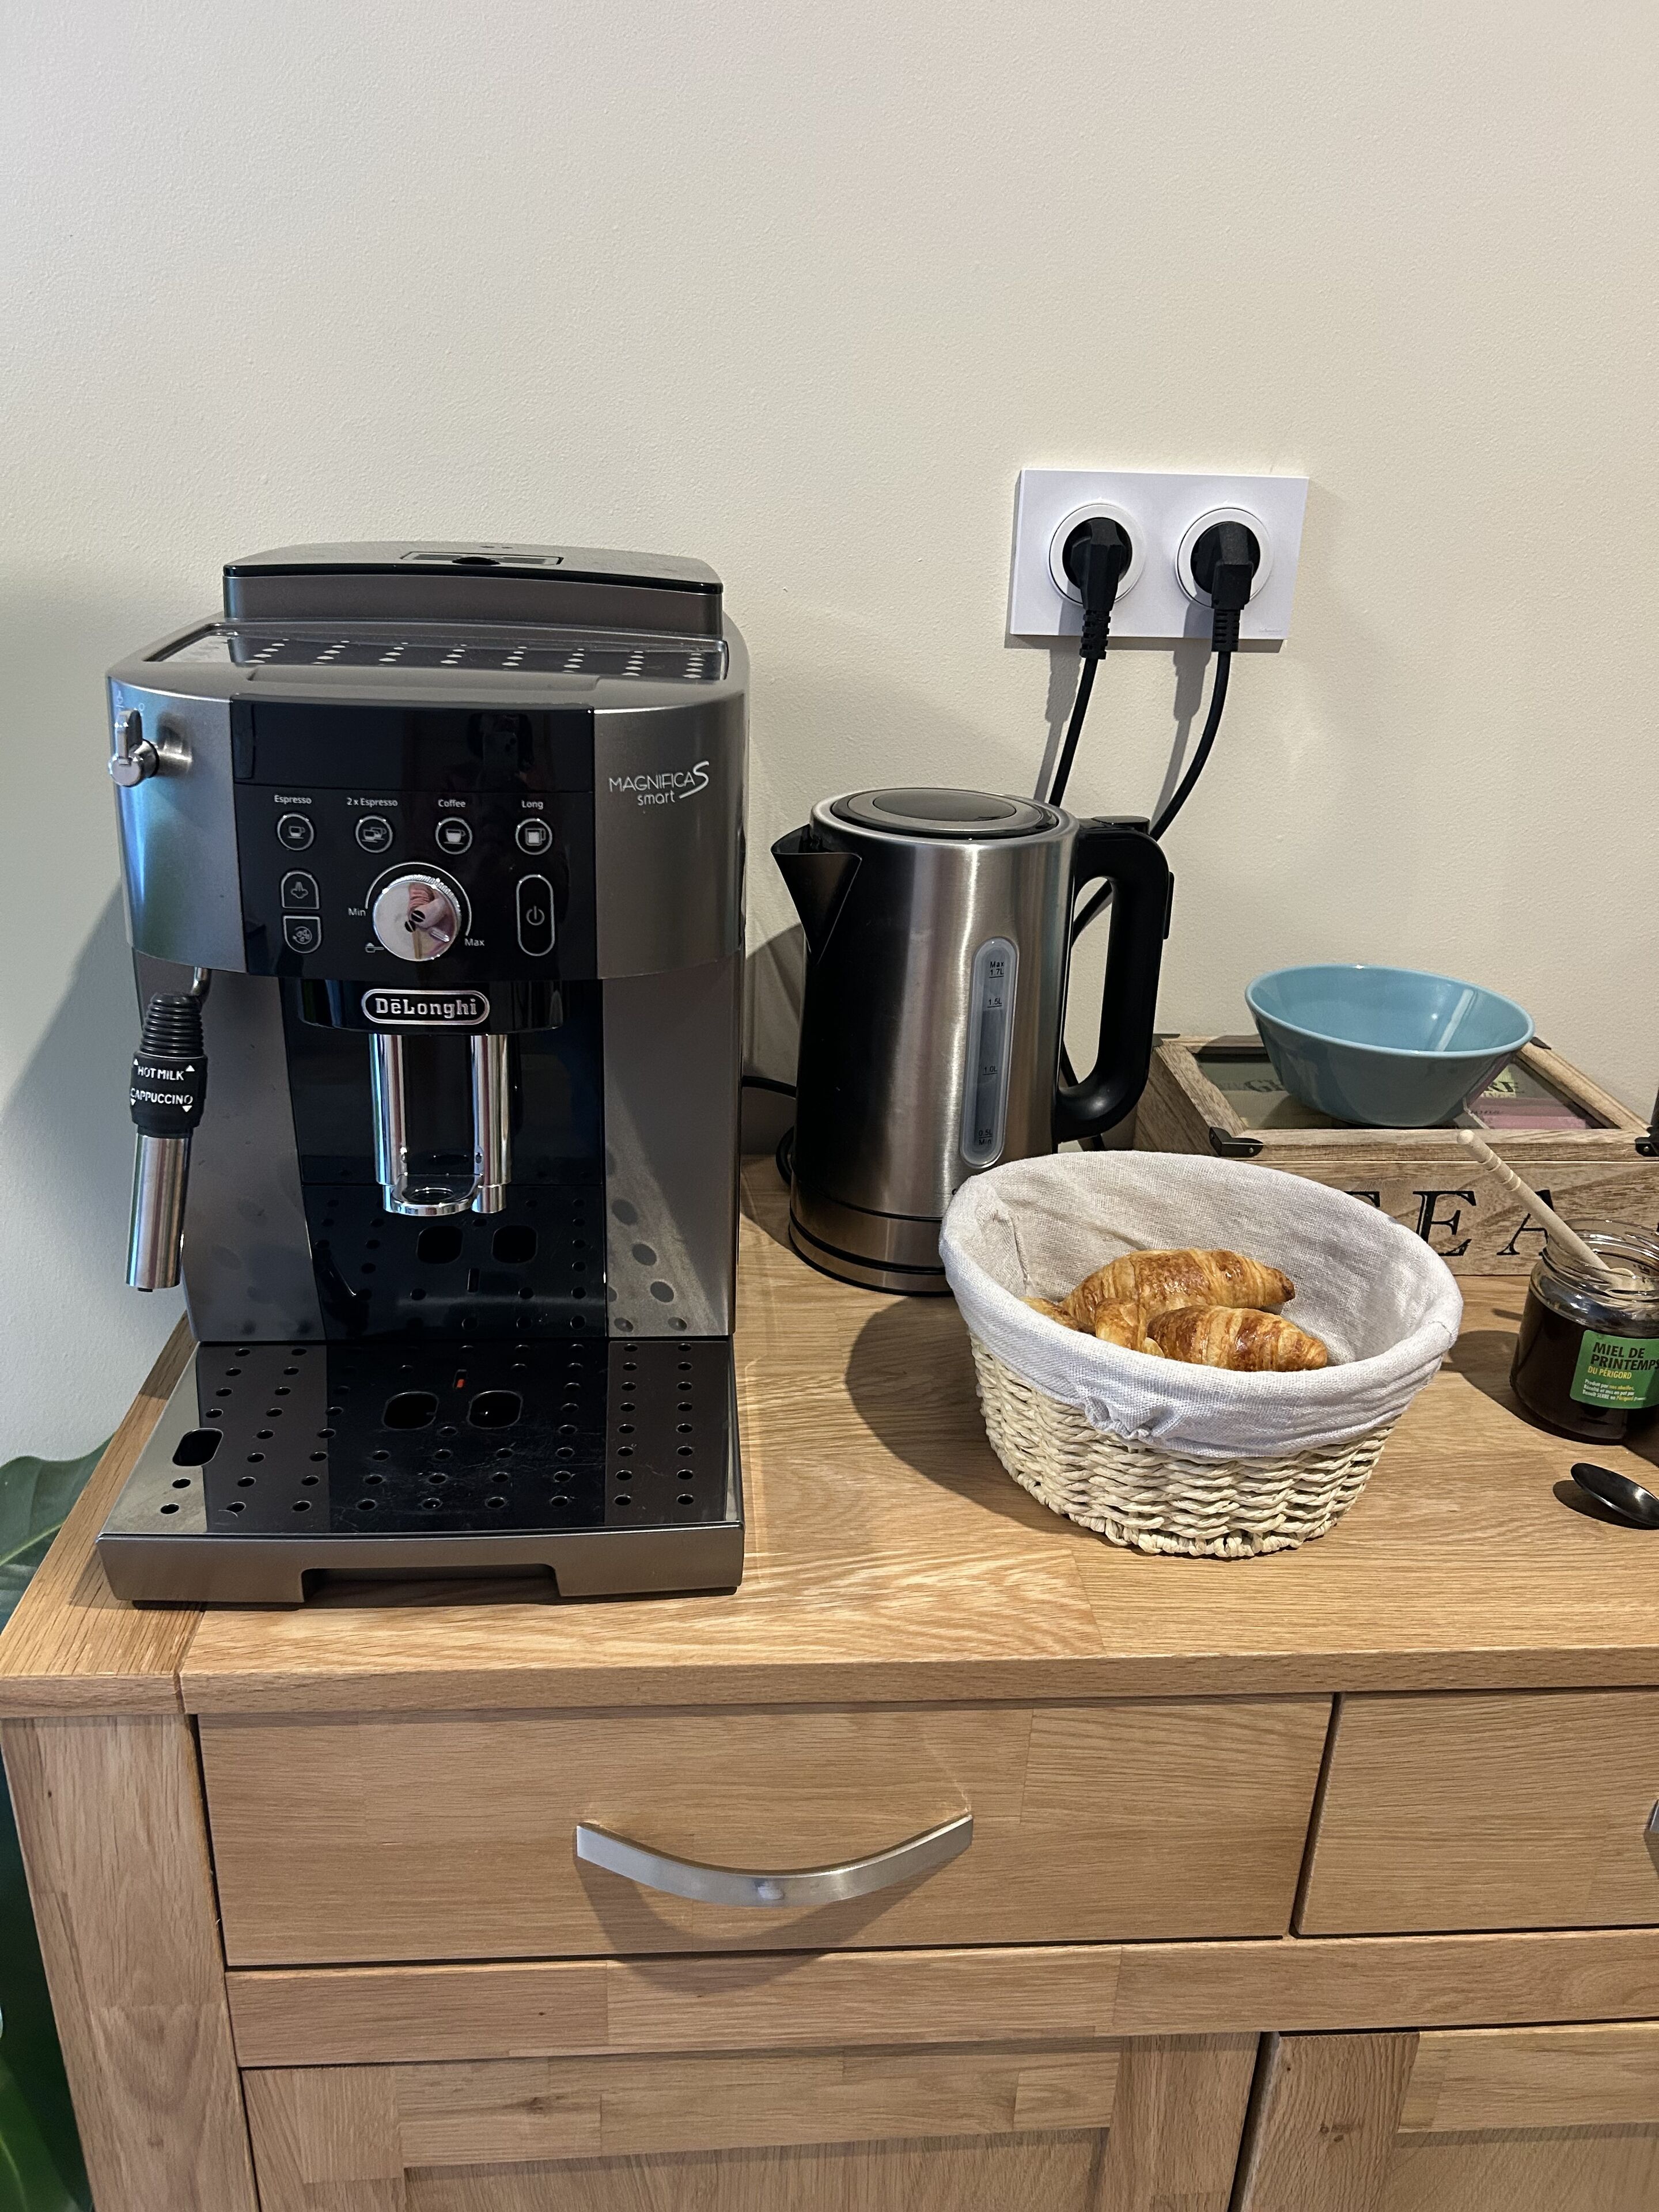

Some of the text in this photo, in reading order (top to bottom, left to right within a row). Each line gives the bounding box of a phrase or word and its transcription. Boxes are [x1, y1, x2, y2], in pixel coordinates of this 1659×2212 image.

[274, 795, 312, 805] Espresso
[347, 797, 353, 805] 2
[360, 798, 398, 808] Espresso
[438, 799, 466, 808] Coffee
[637, 790, 675, 806] smart
[521, 800, 544, 810] Long
[348, 908, 366, 916] Min
[138, 1066, 184, 1081] HOT MILK
[130, 1088, 194, 1105] CAPPUCCINO
[1593, 1342, 1645, 1358] MIEL DE
[1588, 1366, 1632, 1379] DU PÉRIGORD
